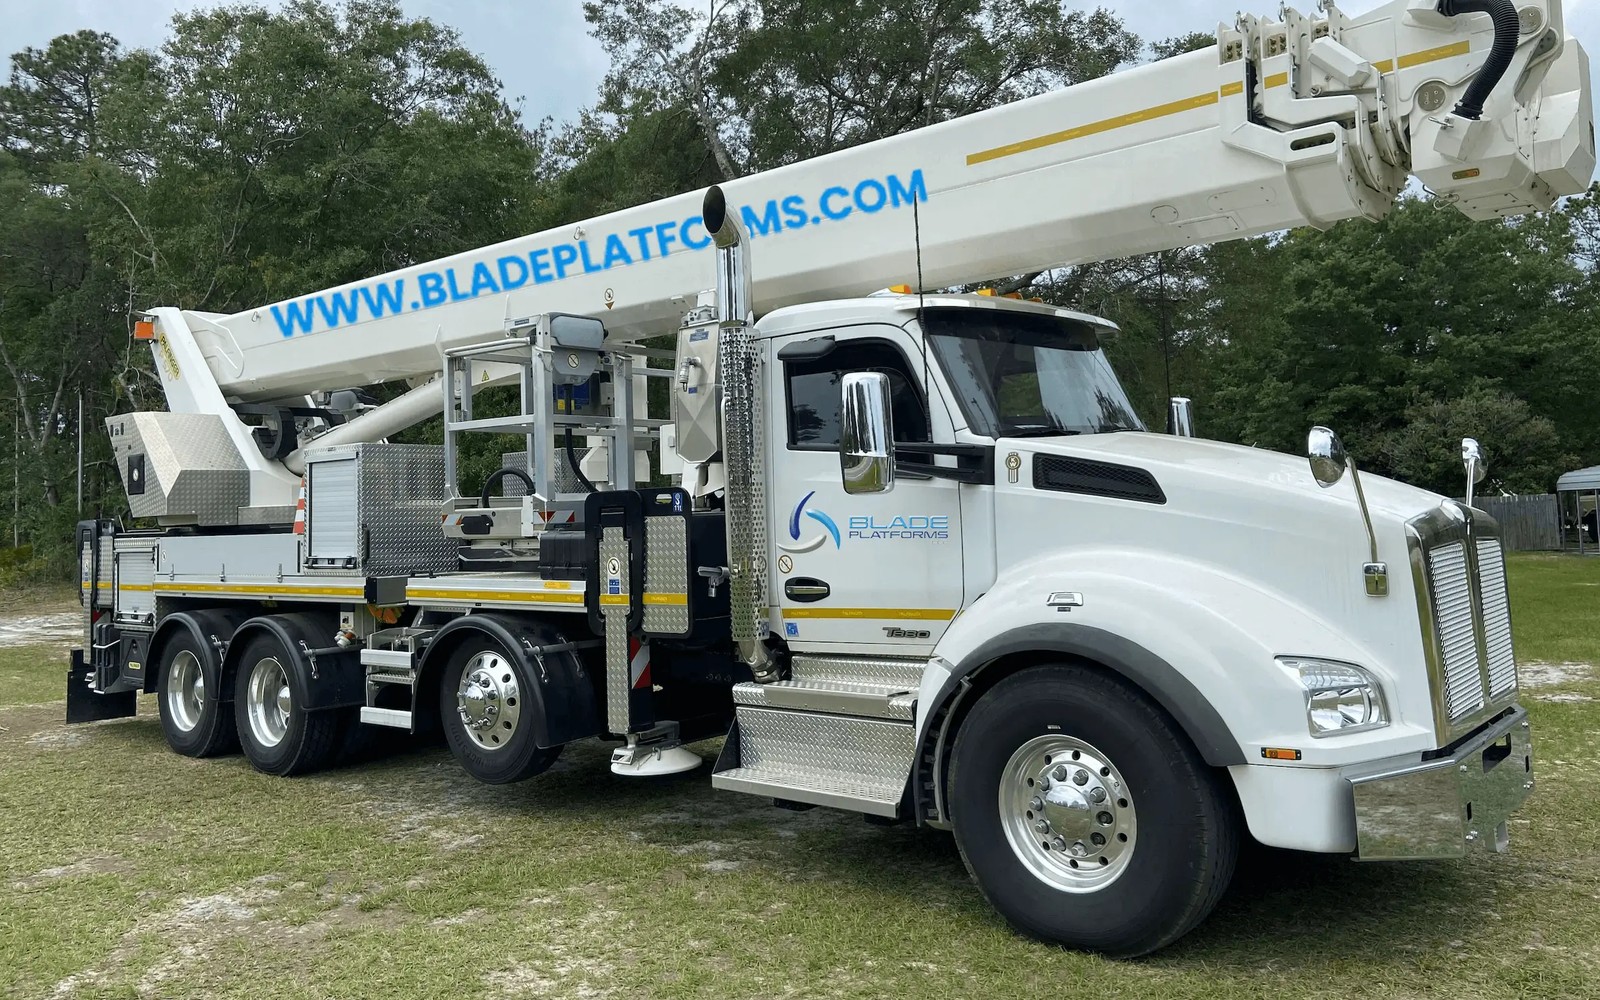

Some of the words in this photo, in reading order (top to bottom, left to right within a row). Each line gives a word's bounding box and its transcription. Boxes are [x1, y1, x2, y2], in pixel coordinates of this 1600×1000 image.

[270, 169, 928, 337] WWW.BLADEPLATFOMS.COM
[849, 515, 949, 529] BLADE
[849, 530, 949, 539] PLATFORMS
